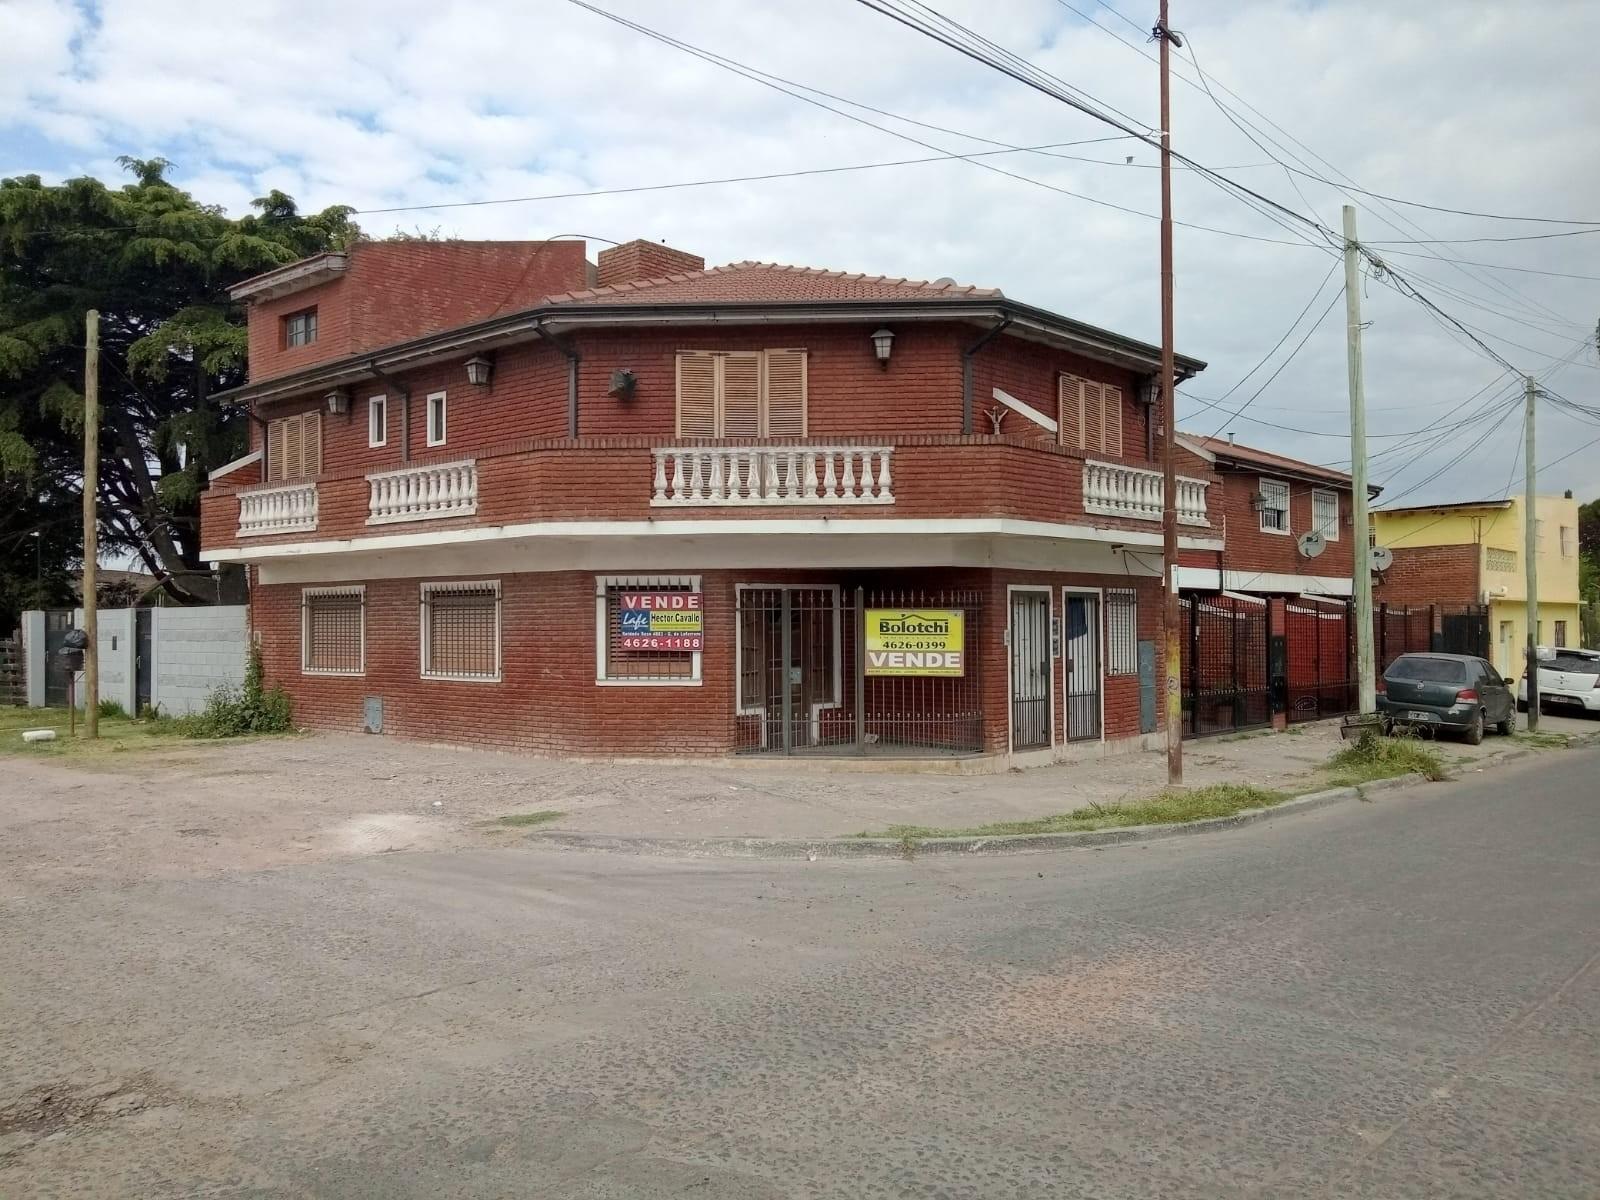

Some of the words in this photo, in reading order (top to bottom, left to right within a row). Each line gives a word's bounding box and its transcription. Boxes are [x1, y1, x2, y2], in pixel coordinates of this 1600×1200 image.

[624, 596, 699, 609] VENDE
[622, 612, 648, 630] Lafe
[651, 613, 673, 623] Hector
[675, 613, 700, 623] Cavallo
[879, 621, 949, 633] Bolotchi
[624, 638, 700, 648] 4626-1188
[882, 641, 946, 649] 4626-0399
[868, 652, 961, 668] VENDE
